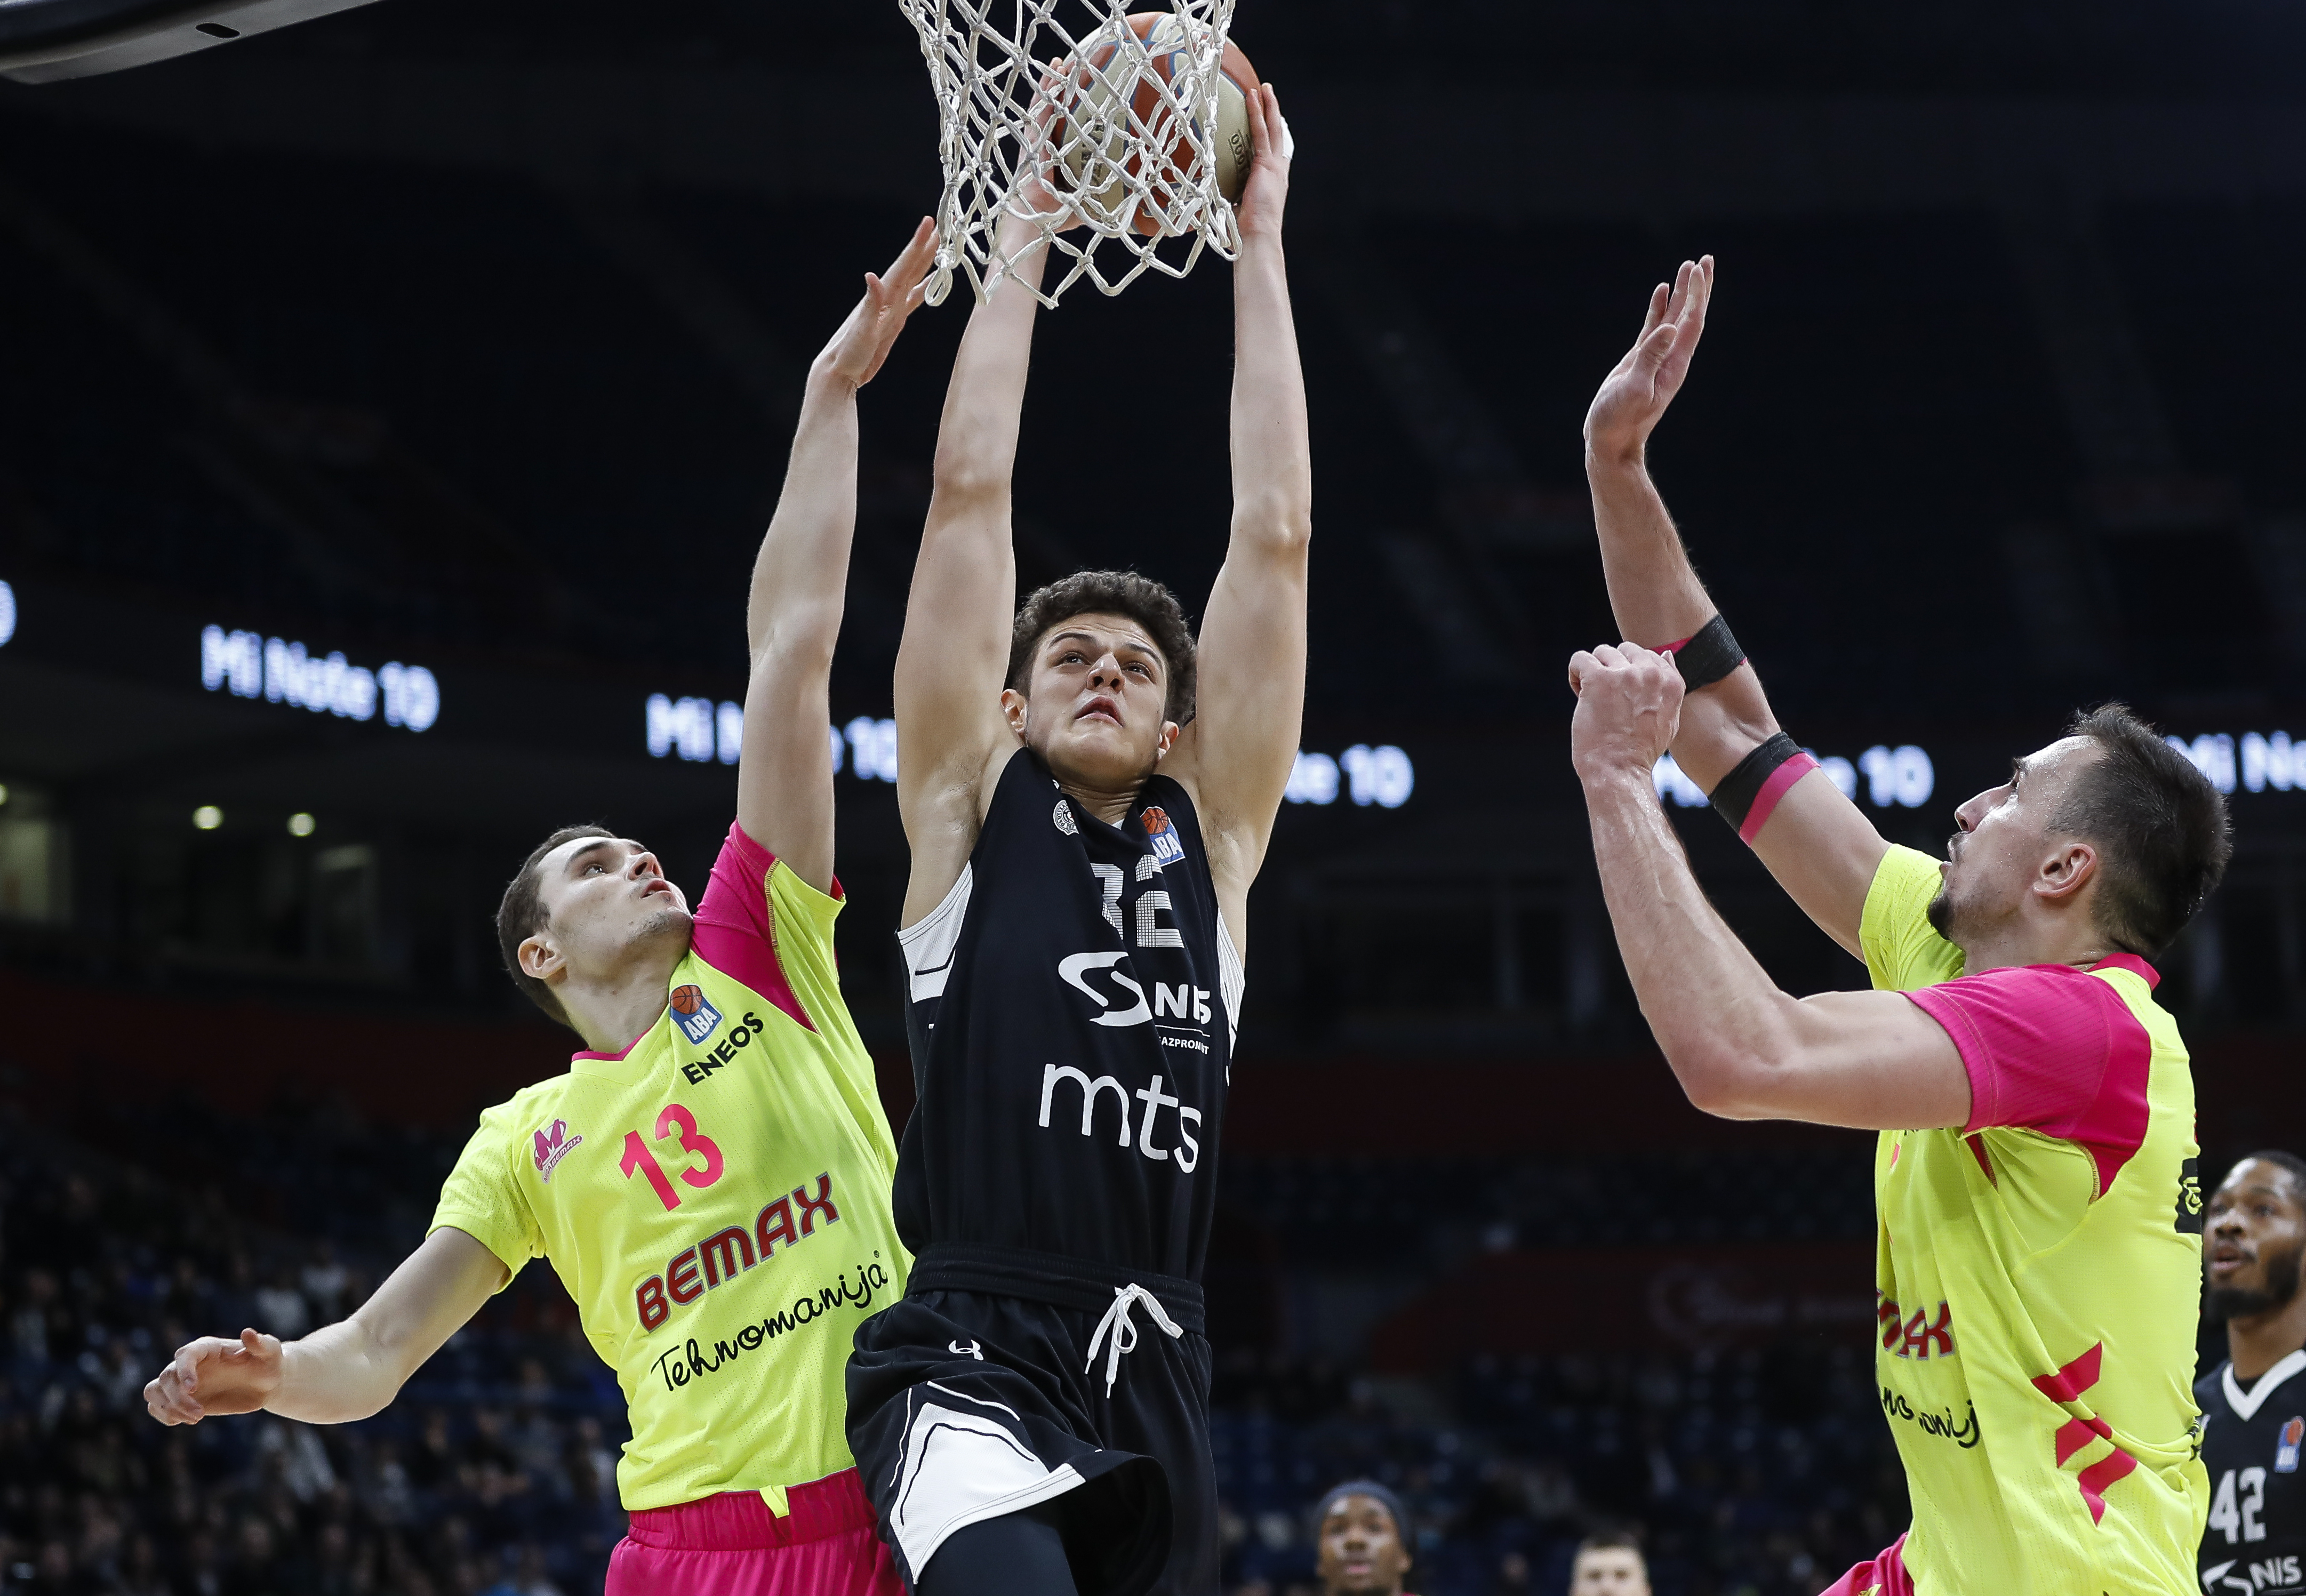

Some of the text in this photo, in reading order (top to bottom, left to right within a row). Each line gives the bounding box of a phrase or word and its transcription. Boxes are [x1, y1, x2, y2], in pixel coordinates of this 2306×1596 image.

[263, 637, 378, 721] Note
[375, 661, 440, 732] 10
[1338, 743, 1415, 809] 10
[1857, 744, 1935, 808] 10
[680, 1012, 764, 1086] ENEOS
[684, 1007, 718, 1040] ABA
[619, 1103, 724, 1212] 13
[1038, 1063, 1202, 1174] mts
[636, 1172, 840, 1334] BEMAX
[651, 1263, 888, 1392] Tehnomanija
[2208, 1466, 2267, 1545] 42
[2248, 1555, 2303, 1592] NIS
